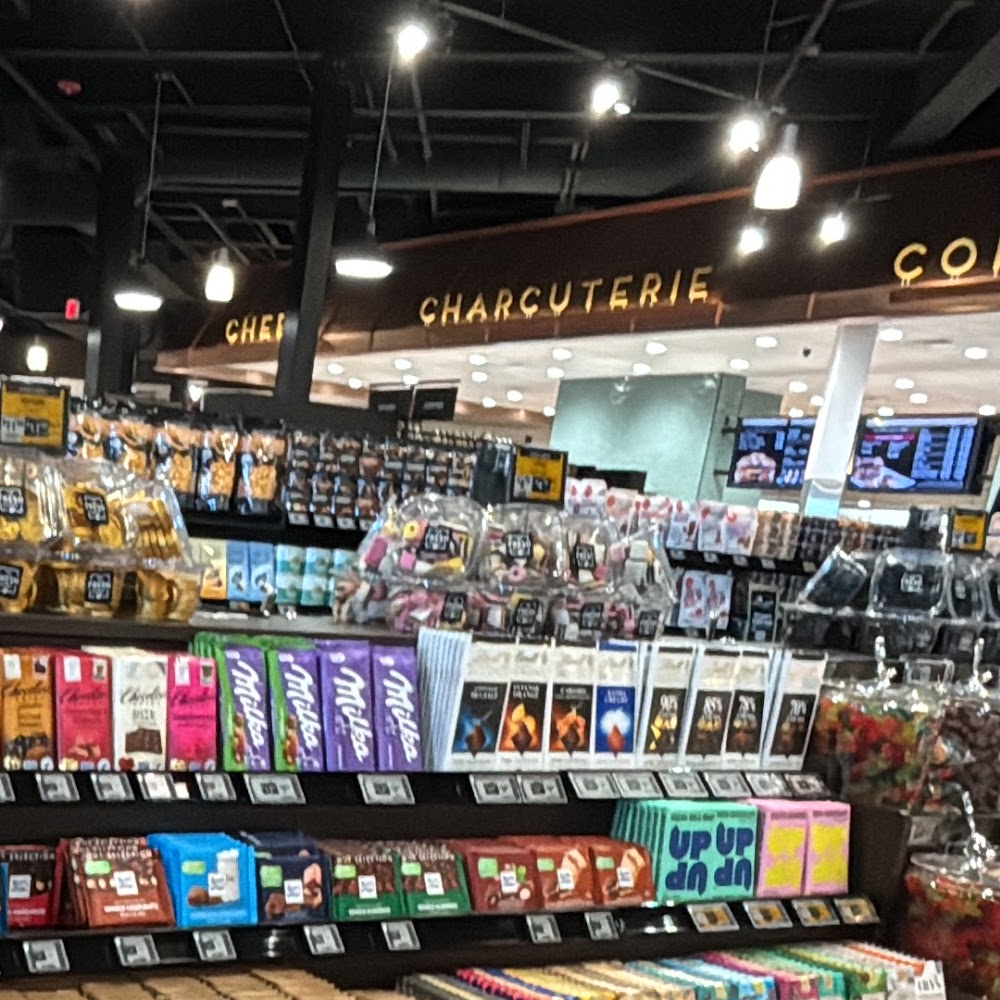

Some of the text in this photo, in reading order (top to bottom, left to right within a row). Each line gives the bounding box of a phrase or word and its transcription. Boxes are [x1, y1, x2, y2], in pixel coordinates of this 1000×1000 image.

[419, 265, 713, 327] CHARCUTERIE
[893, 237, 1000, 280] CO
[231, 660, 268, 753] Milka
[283, 662, 322, 752] Milka
[333, 666, 374, 763] Milka
[382, 669, 421, 763] Milka
[669, 824, 712, 860] UP
[715, 821, 754, 859] UP
